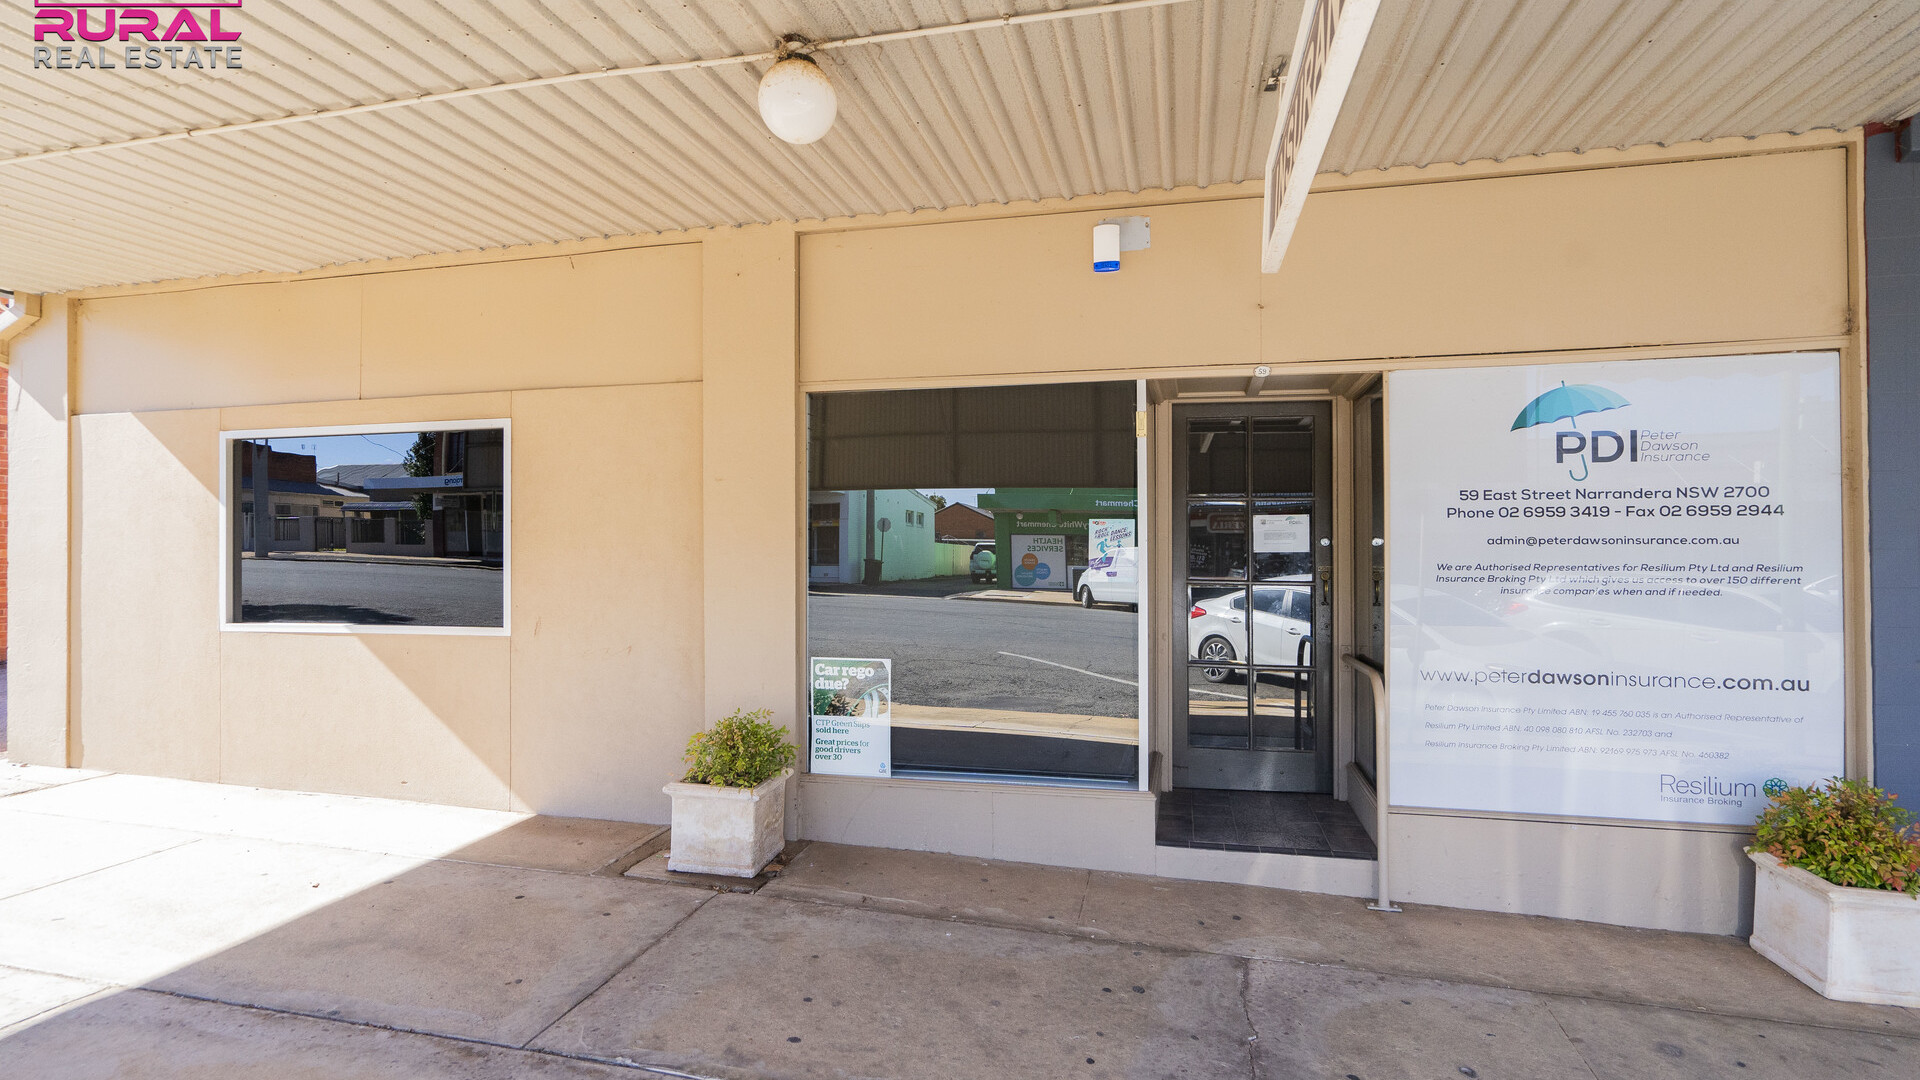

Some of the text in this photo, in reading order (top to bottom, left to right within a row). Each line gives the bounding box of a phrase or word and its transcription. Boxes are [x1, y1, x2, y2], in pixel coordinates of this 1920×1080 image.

[1640, 430, 1681, 441] Peter
[1556, 430, 1638, 463] PDI
[1640, 440, 1698, 452] Dawson
[1640, 451, 1710, 462] Insurance
[1459, 486, 1770, 502] 59 East Street Narrandera NSW 2700
[1446, 507, 1494, 519] Phone
[1498, 507, 1520, 518] 02
[1523, 506, 1566, 518] 6959
[1570, 506, 1610, 518] 3419
[1626, 506, 1655, 518] Fax
[1660, 506, 1682, 518] 02
[1686, 505, 1732, 518] 6959
[1736, 504, 1785, 517] 2944
[1487, 536, 1740, 547] admin@peterdawsoninsurance.com.au
[1436, 563, 1452, 571] We
[1474, 563, 1532, 572] Authorised
[1533, 563, 1620, 572] Representatives
[1622, 564, 1638, 572] for
[1640, 564, 1686, 572] Resilium
[1688, 564, 1708, 574] Pty
[1710, 564, 1730, 572] Ltd
[1732, 564, 1754, 572] and
[1756, 564, 1804, 572] Resilium
[1436, 575, 1486, 583] Insurance
[1488, 575, 1526, 585] Broking
[1528, 576, 1546, 584] Pty
[1569, 575, 1600, 584] which
[1602, 576, 1630, 585] gives
[1686, 576, 1697, 584] to
[1727, 576, 1748, 584] 150
[1750, 576, 1801, 584] different
[1553, 587, 1610, 596] companies
[1613, 588, 1642, 596] when
[1645, 588, 1666, 596] and
[1668, 588, 1676, 596] if
[1678, 588, 1722, 596] needed.
[814, 664, 874, 680] Car rego
[814, 678, 850, 690] due?
[1420, 668, 1810, 692] www.peterdawsoninsurance.com.au
[1425, 704, 1446, 712] Peter
[1447, 704, 1480, 712] Dawson
[1481, 705, 1521, 714] Insurance
[1523, 706, 1536, 716] Pty
[1538, 707, 1567, 716] Limited
[1619, 710, 1634, 718] 760
[1636, 710, 1650, 718] 035
[1674, 712, 1722, 720] Authorised
[1724, 714, 1792, 724] Representative
[1794, 716, 1804, 724] of
[1425, 722, 1456, 730] Resilium
[1458, 723, 1470, 732] Pty
[1472, 723, 1500, 732] Limited
[1622, 730, 1652, 738] 232703
[1655, 730, 1672, 738] and
[836, 738, 858, 746] prices
[834, 746, 861, 754] drivers
[1425, 740, 1456, 748] Resilium
[1458, 741, 1498, 750] Insurance
[1500, 742, 1530, 752] Broking
[1532, 744, 1544, 753] Pty
[1546, 745, 1576, 753] Limited
[1698, 752, 1730, 760] 460382
[1660, 774, 1756, 797] Resilium
[1660, 794, 1742, 808] Insurance Broking
